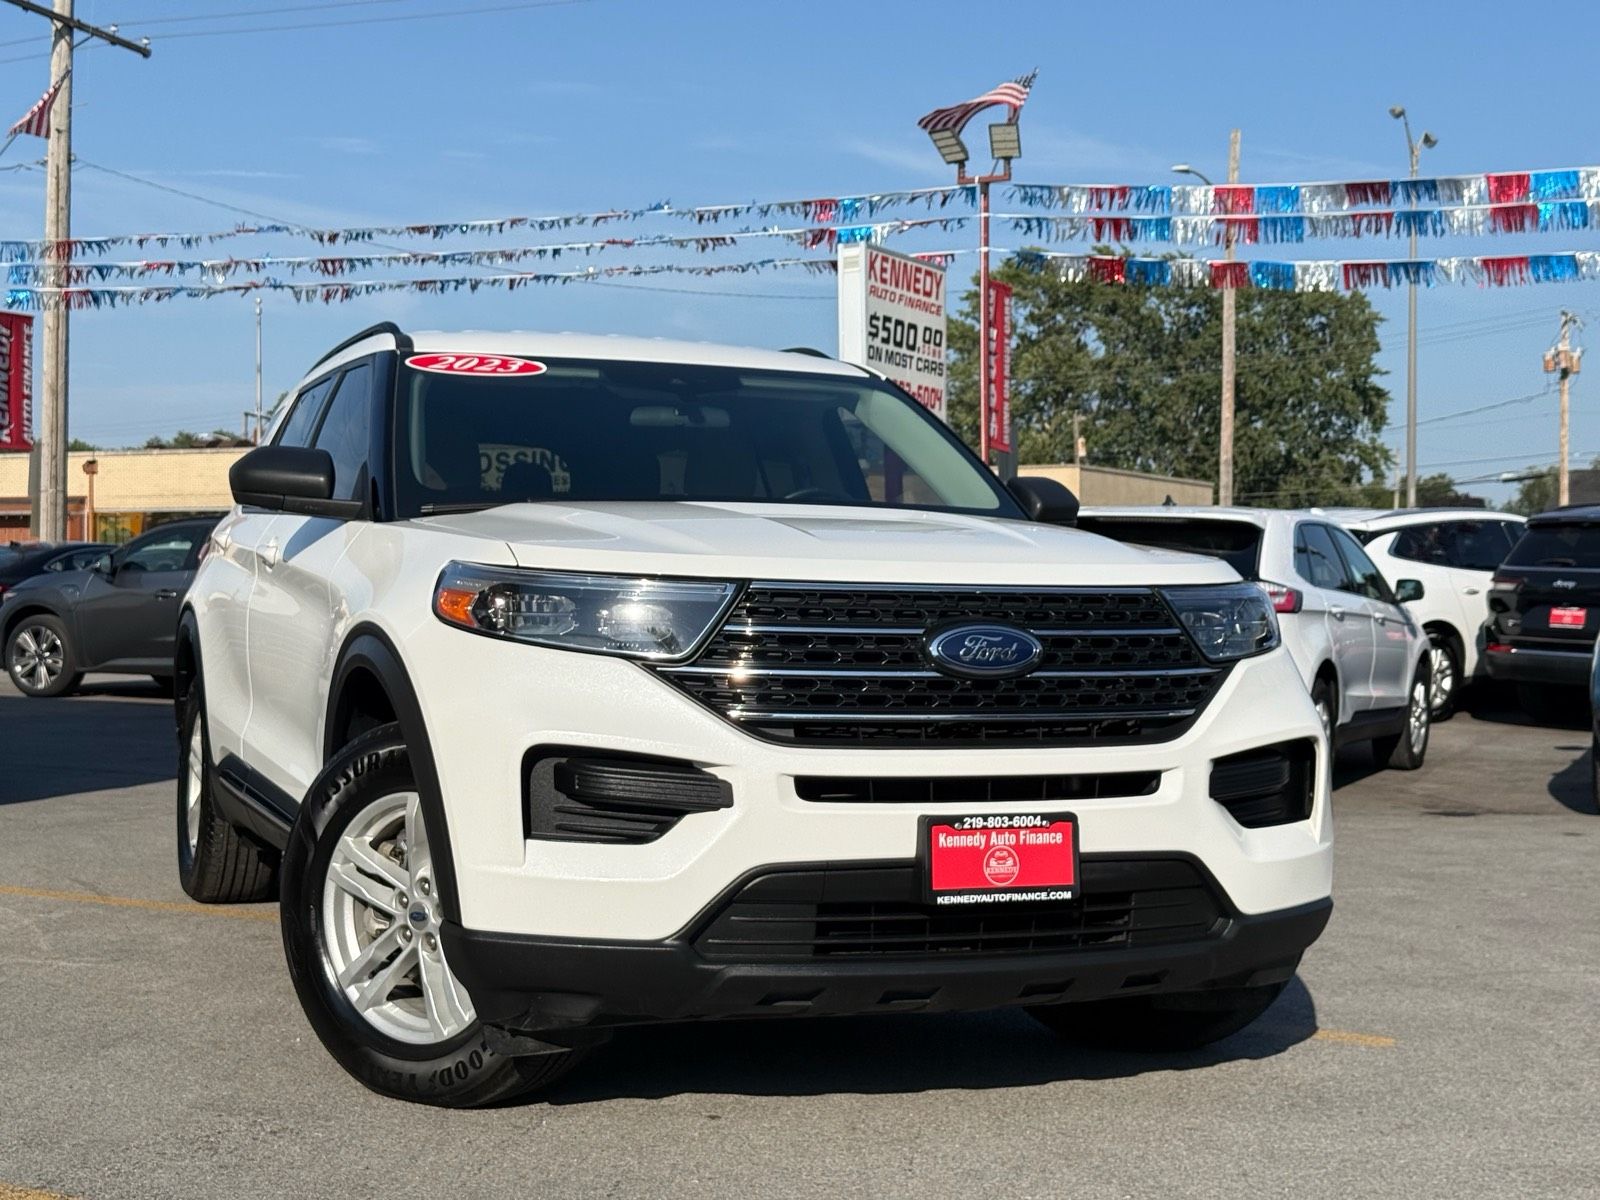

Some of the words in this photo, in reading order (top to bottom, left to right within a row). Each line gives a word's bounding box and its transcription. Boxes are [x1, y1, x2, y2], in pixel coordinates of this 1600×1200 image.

[868, 251, 944, 300] KENNEDY
[869, 285, 898, 303] AUTO
[898, 293, 943, 317] FINANCE
[23, 323, 33, 396] FINANCE
[427, 356, 526, 373] 2023
[867, 345, 883, 363] ON
[884, 349, 914, 370] MOST
[916, 357, 944, 377] CARS
[23, 399, 34, 445] AUTO
[959, 634, 1018, 662] Ford
[963, 815, 1041, 829] 219-803-6004
[938, 832, 987, 849] Kennedy
[990, 833, 1016, 846] Auto
[1020, 831, 1063, 845] Finance
[937, 891, 1072, 905] KENNEDYAUTOFINANCE.COM
